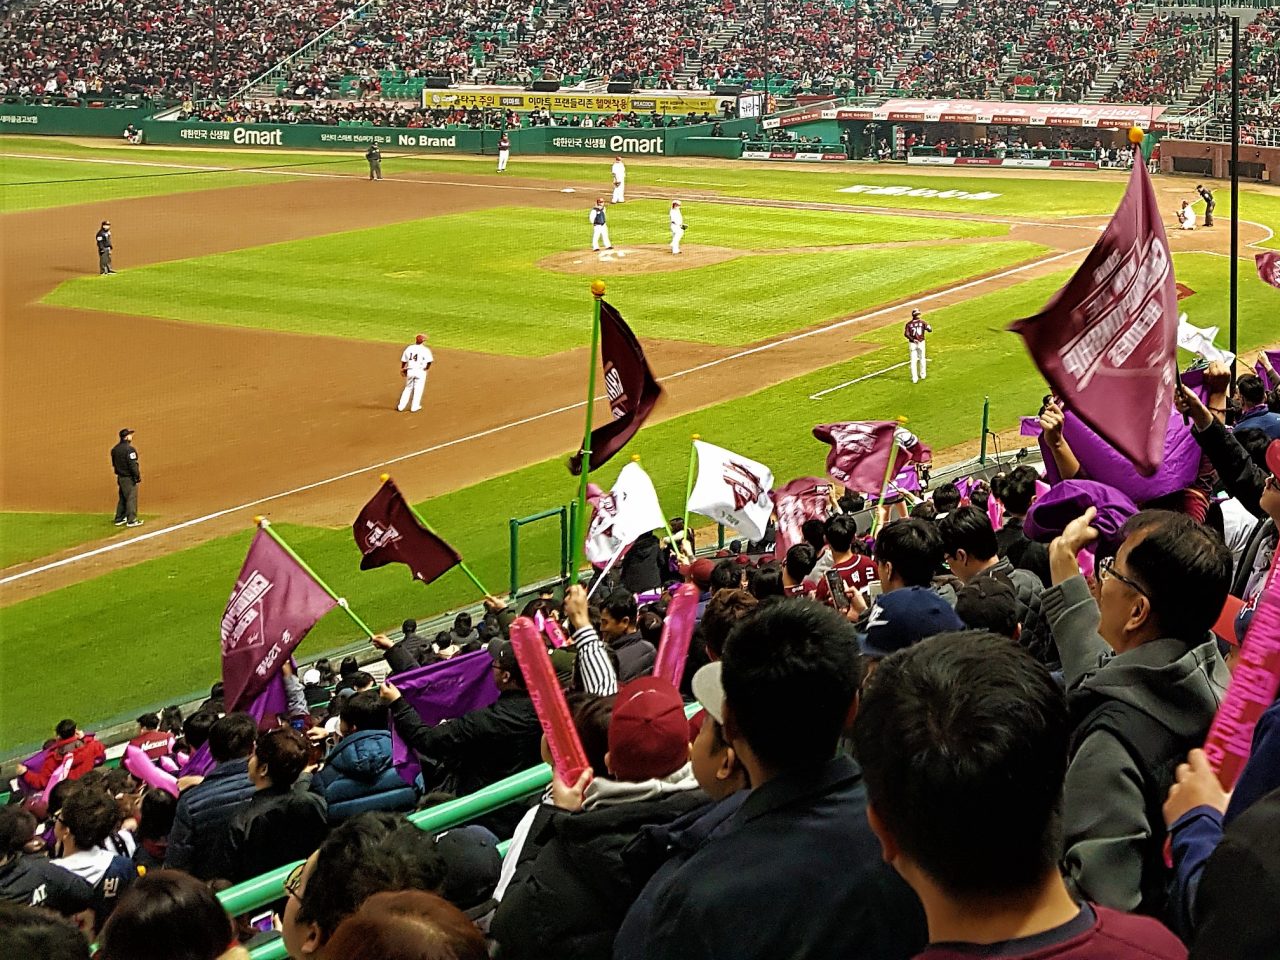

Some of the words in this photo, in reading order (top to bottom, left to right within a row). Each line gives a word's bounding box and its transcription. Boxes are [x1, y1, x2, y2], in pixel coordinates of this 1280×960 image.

[478, 95, 495, 105] 주의
[528, 97, 550, 106] 이마트
[596, 98, 627, 109] 헬멧착용
[180, 129, 207, 139] 대한민국
[210, 130, 230, 140] 신생활
[234, 127, 282, 145] emart
[399, 135, 415, 145] No
[419, 135, 456, 147] Brand
[553, 137, 582, 148] 대한민국
[584, 138, 606, 148] 신생활
[610, 135, 663, 153] emart
[409, 352, 418, 362] 14
